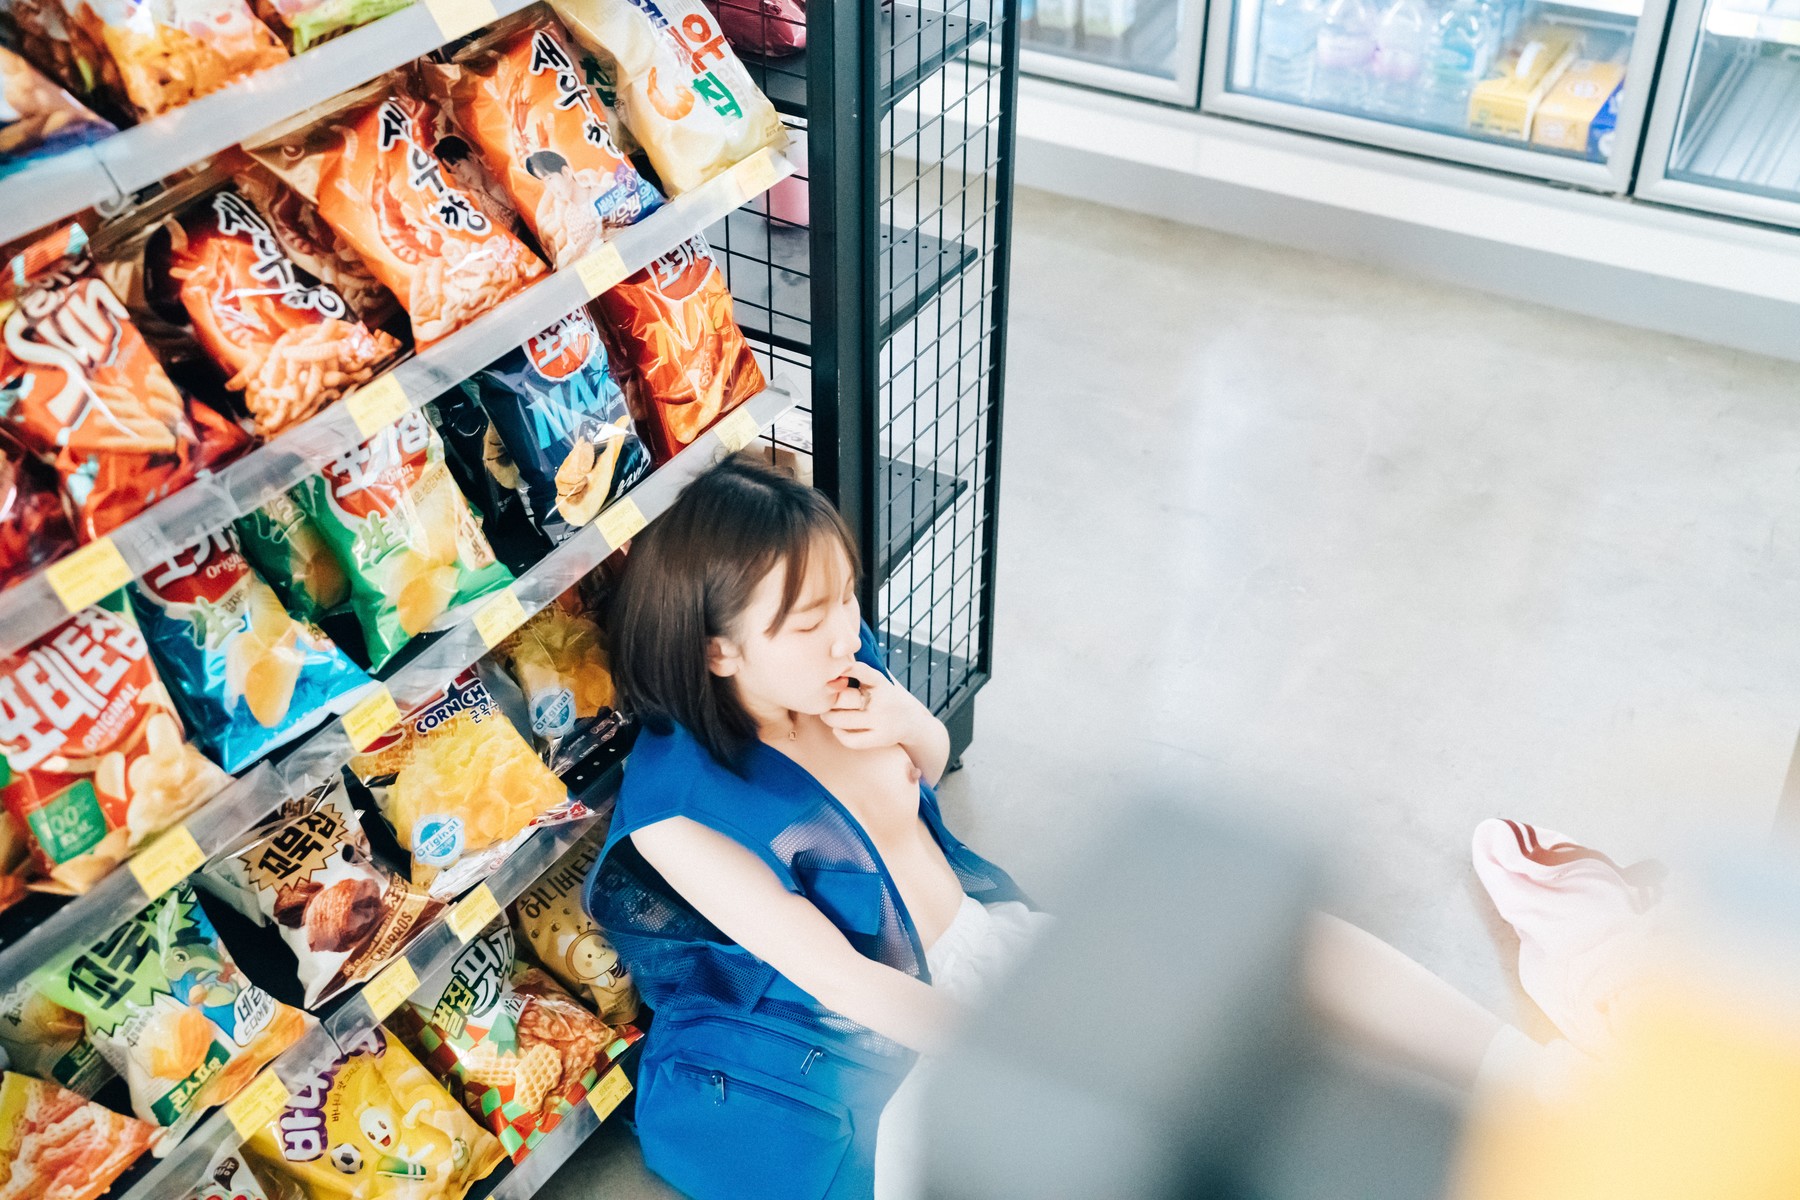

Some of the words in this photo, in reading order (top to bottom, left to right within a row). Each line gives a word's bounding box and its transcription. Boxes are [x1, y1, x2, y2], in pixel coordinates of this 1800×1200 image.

[377, 101, 492, 236] 새우깡
[82, 681, 140, 751] ORIGINAL
[414, 695, 462, 736] CORN
[259, 811, 338, 880] 꼬북칩
[415, 818, 460, 858] Original
